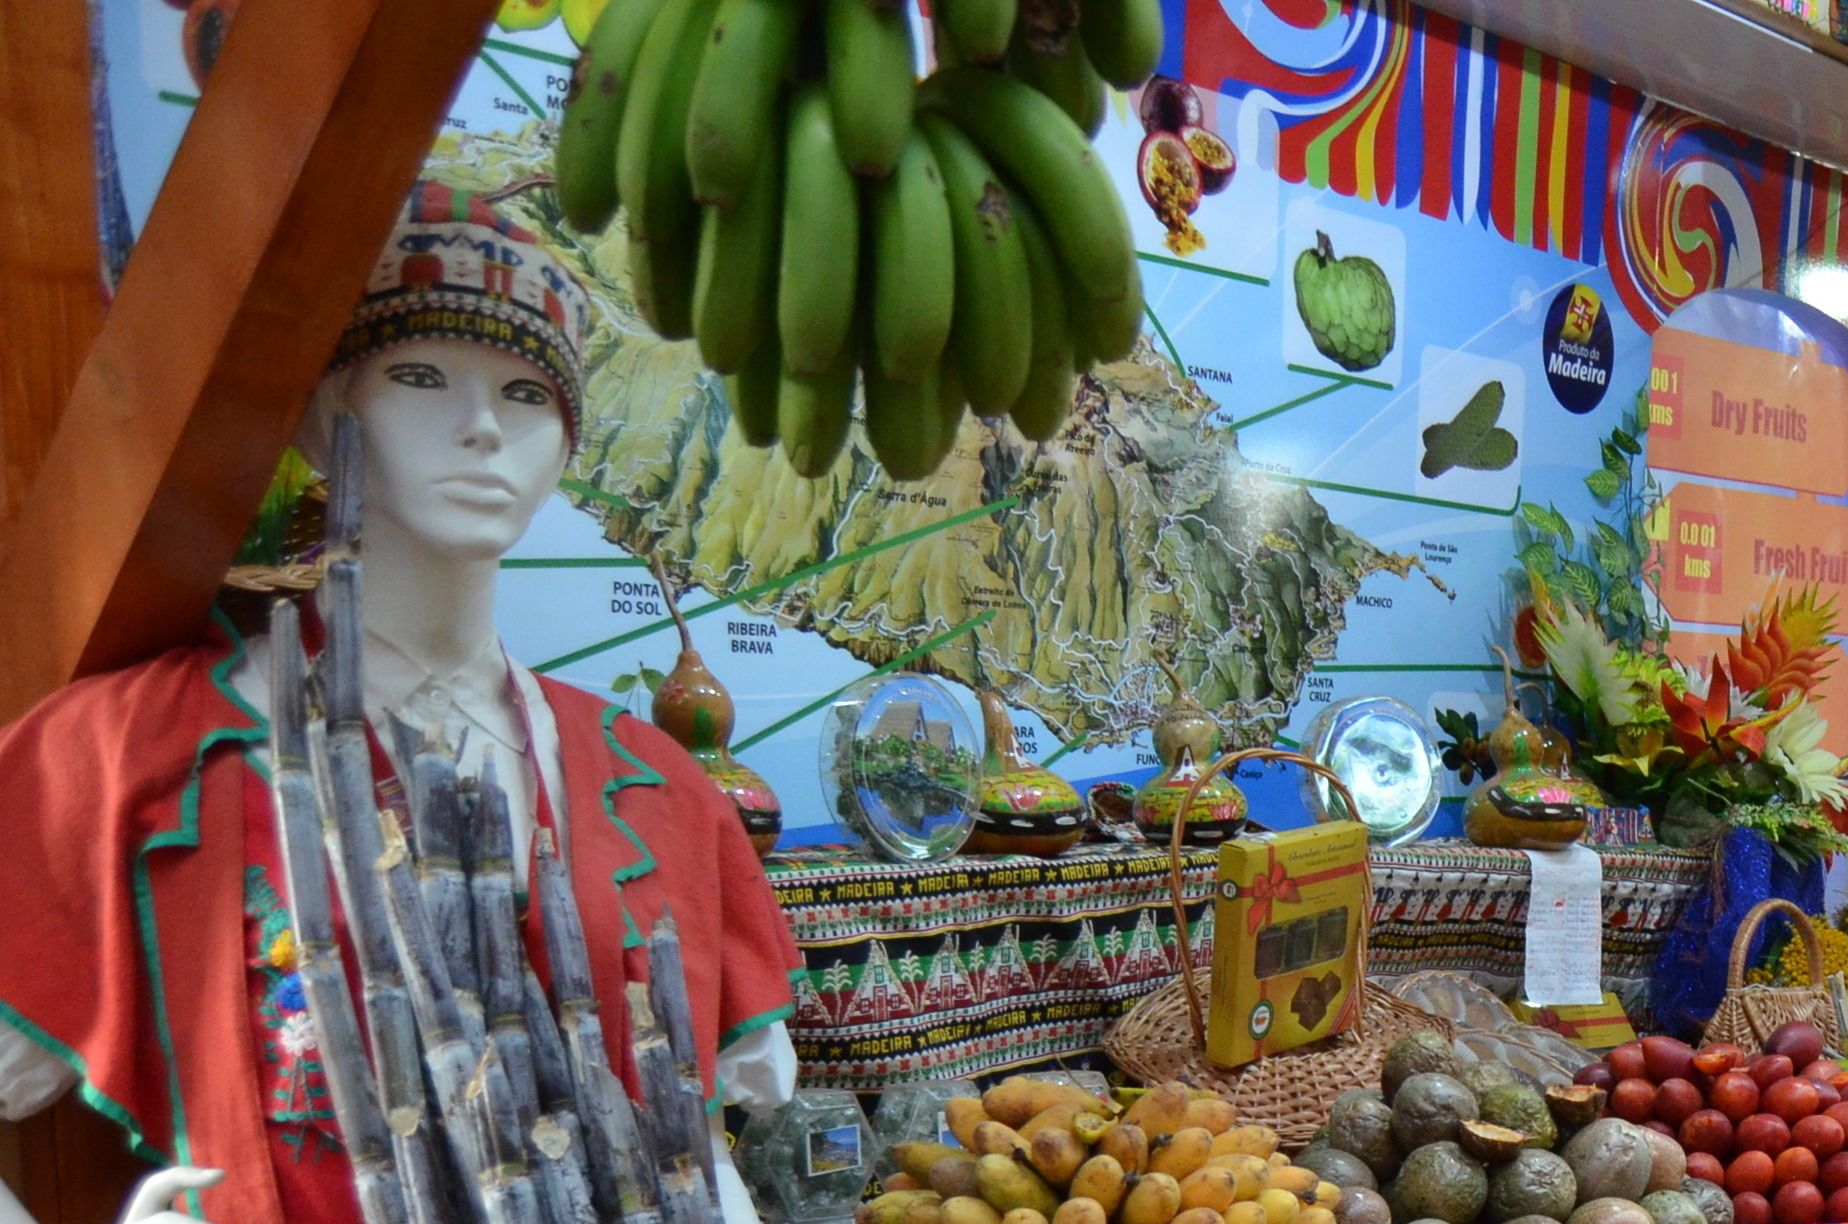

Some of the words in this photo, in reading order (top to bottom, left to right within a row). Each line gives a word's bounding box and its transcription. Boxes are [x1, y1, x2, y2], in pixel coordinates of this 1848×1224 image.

[494, 97, 529, 115] Santa
[408, 311, 513, 341] MADEIRA
[1558, 339, 1589, 358] Produto
[1589, 348, 1600, 361] da
[1188, 365, 1233, 384] SANTANA
[1548, 352, 1607, 386] Madeira
[1216, 412, 1234, 424] Faial
[1711, 390, 1747, 436] Dry
[1752, 398, 1808, 443] Fruits
[877, 489, 907, 504] Serra
[1684, 554, 1712, 579] kms
[1753, 538, 1806, 581] Fresh
[613, 581, 661, 597] PONTA
[611, 599, 633, 614] DO
[636, 601, 662, 616] SOL
[1355, 596, 1393, 609] MACHICO
[727, 621, 777, 638] RIBEIRA
[731, 639, 774, 655] BRAVA
[1307, 677, 1335, 689] SANTA
[1309, 691, 1331, 702] CRUZ
[775, 888, 814, 905] DEIRA
[836, 881, 895, 900] MADEIRA
[988, 868, 1040, 885] MADEIRA
[1060, 862, 1110, 881] MADEIRA
[851, 1034, 912, 1056] MADEIRA
[1047, 1002, 1100, 1019] MADEIRA
